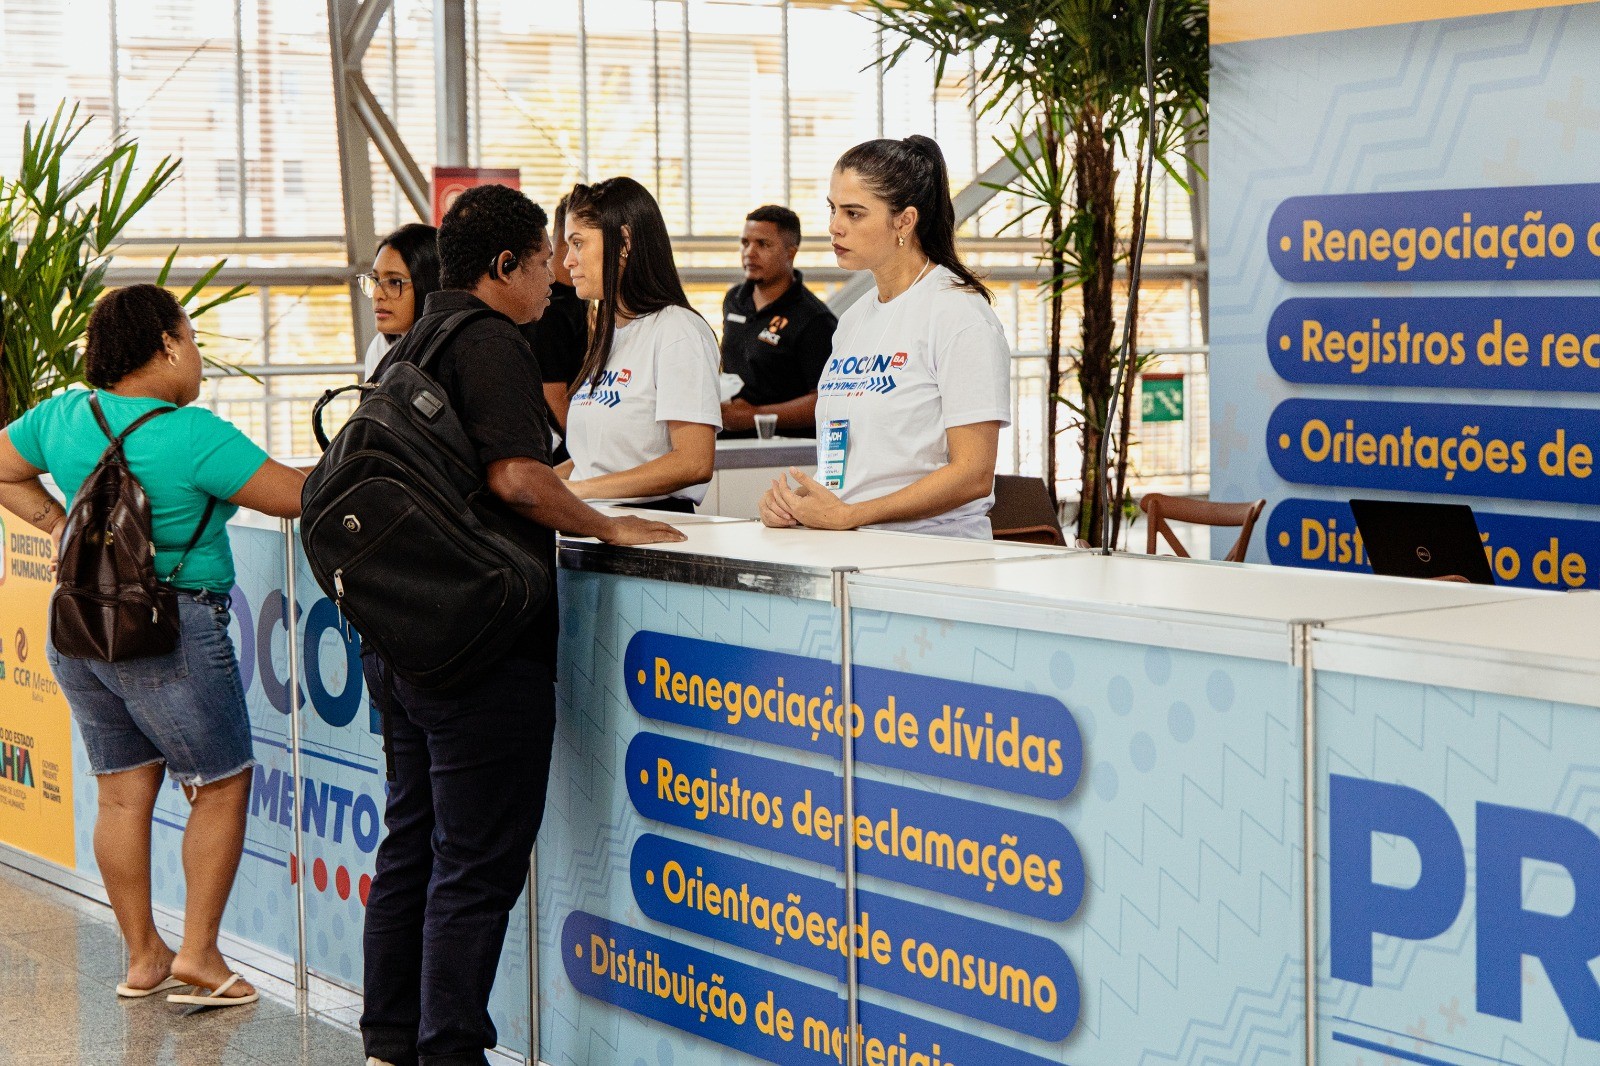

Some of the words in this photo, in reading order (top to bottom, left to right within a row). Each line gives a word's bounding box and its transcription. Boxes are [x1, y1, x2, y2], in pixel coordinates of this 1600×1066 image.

[1302, 211, 1574, 272] Renegociação
[893, 355, 905, 363] BA
[1302, 319, 1465, 374] Registros
[1477, 319, 1528, 367] de
[1301, 420, 1527, 481] Orientações
[1539, 429, 1593, 478] de
[11, 533, 52, 559] DIREITOS
[11, 558, 53, 583] HUMANOS
[1532, 537, 1587, 587] de
[14, 667, 31, 688] CCR
[32, 672, 58, 695] Metro
[655, 656, 865, 743] Renegociação
[874, 696, 918, 749] de
[929, 705, 1063, 776] dívidas
[656, 757, 784, 829] Registros
[792, 790, 833, 840] de
[834, 809, 1062, 896] reclamações
[661, 861, 838, 951] Orientações
[837, 912, 891, 964] de
[900, 939, 1057, 1014] consumo
[590, 935, 747, 1025] Distribuição
[754, 990, 794, 1042] de
